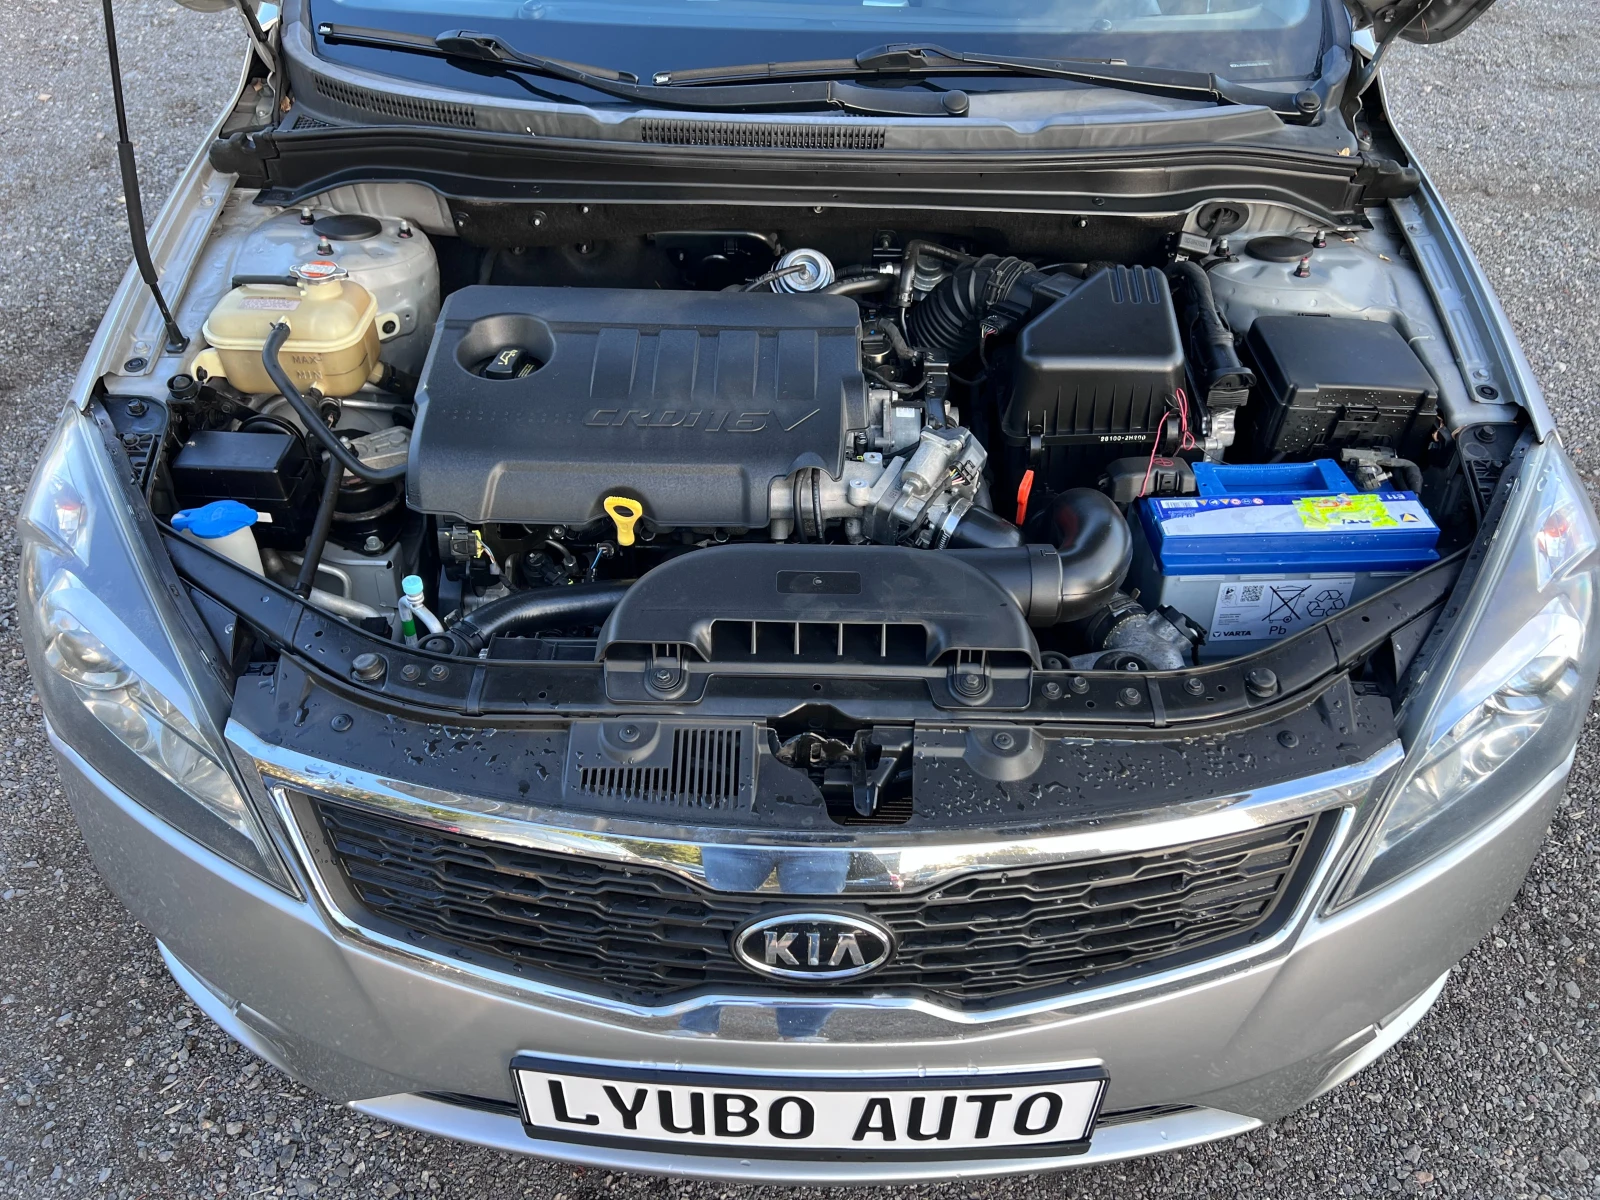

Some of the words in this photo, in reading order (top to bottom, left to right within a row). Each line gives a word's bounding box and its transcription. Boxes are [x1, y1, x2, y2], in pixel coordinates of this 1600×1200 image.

[292, 355, 318, 364] MAX
[297, 370, 323, 380] MIN
[1269, 625, 1287, 635] Pb
[764, 931, 865, 966] KIA
[548, 1079, 815, 1139] LYUBO
[852, 1091, 1063, 1141] AUTO
